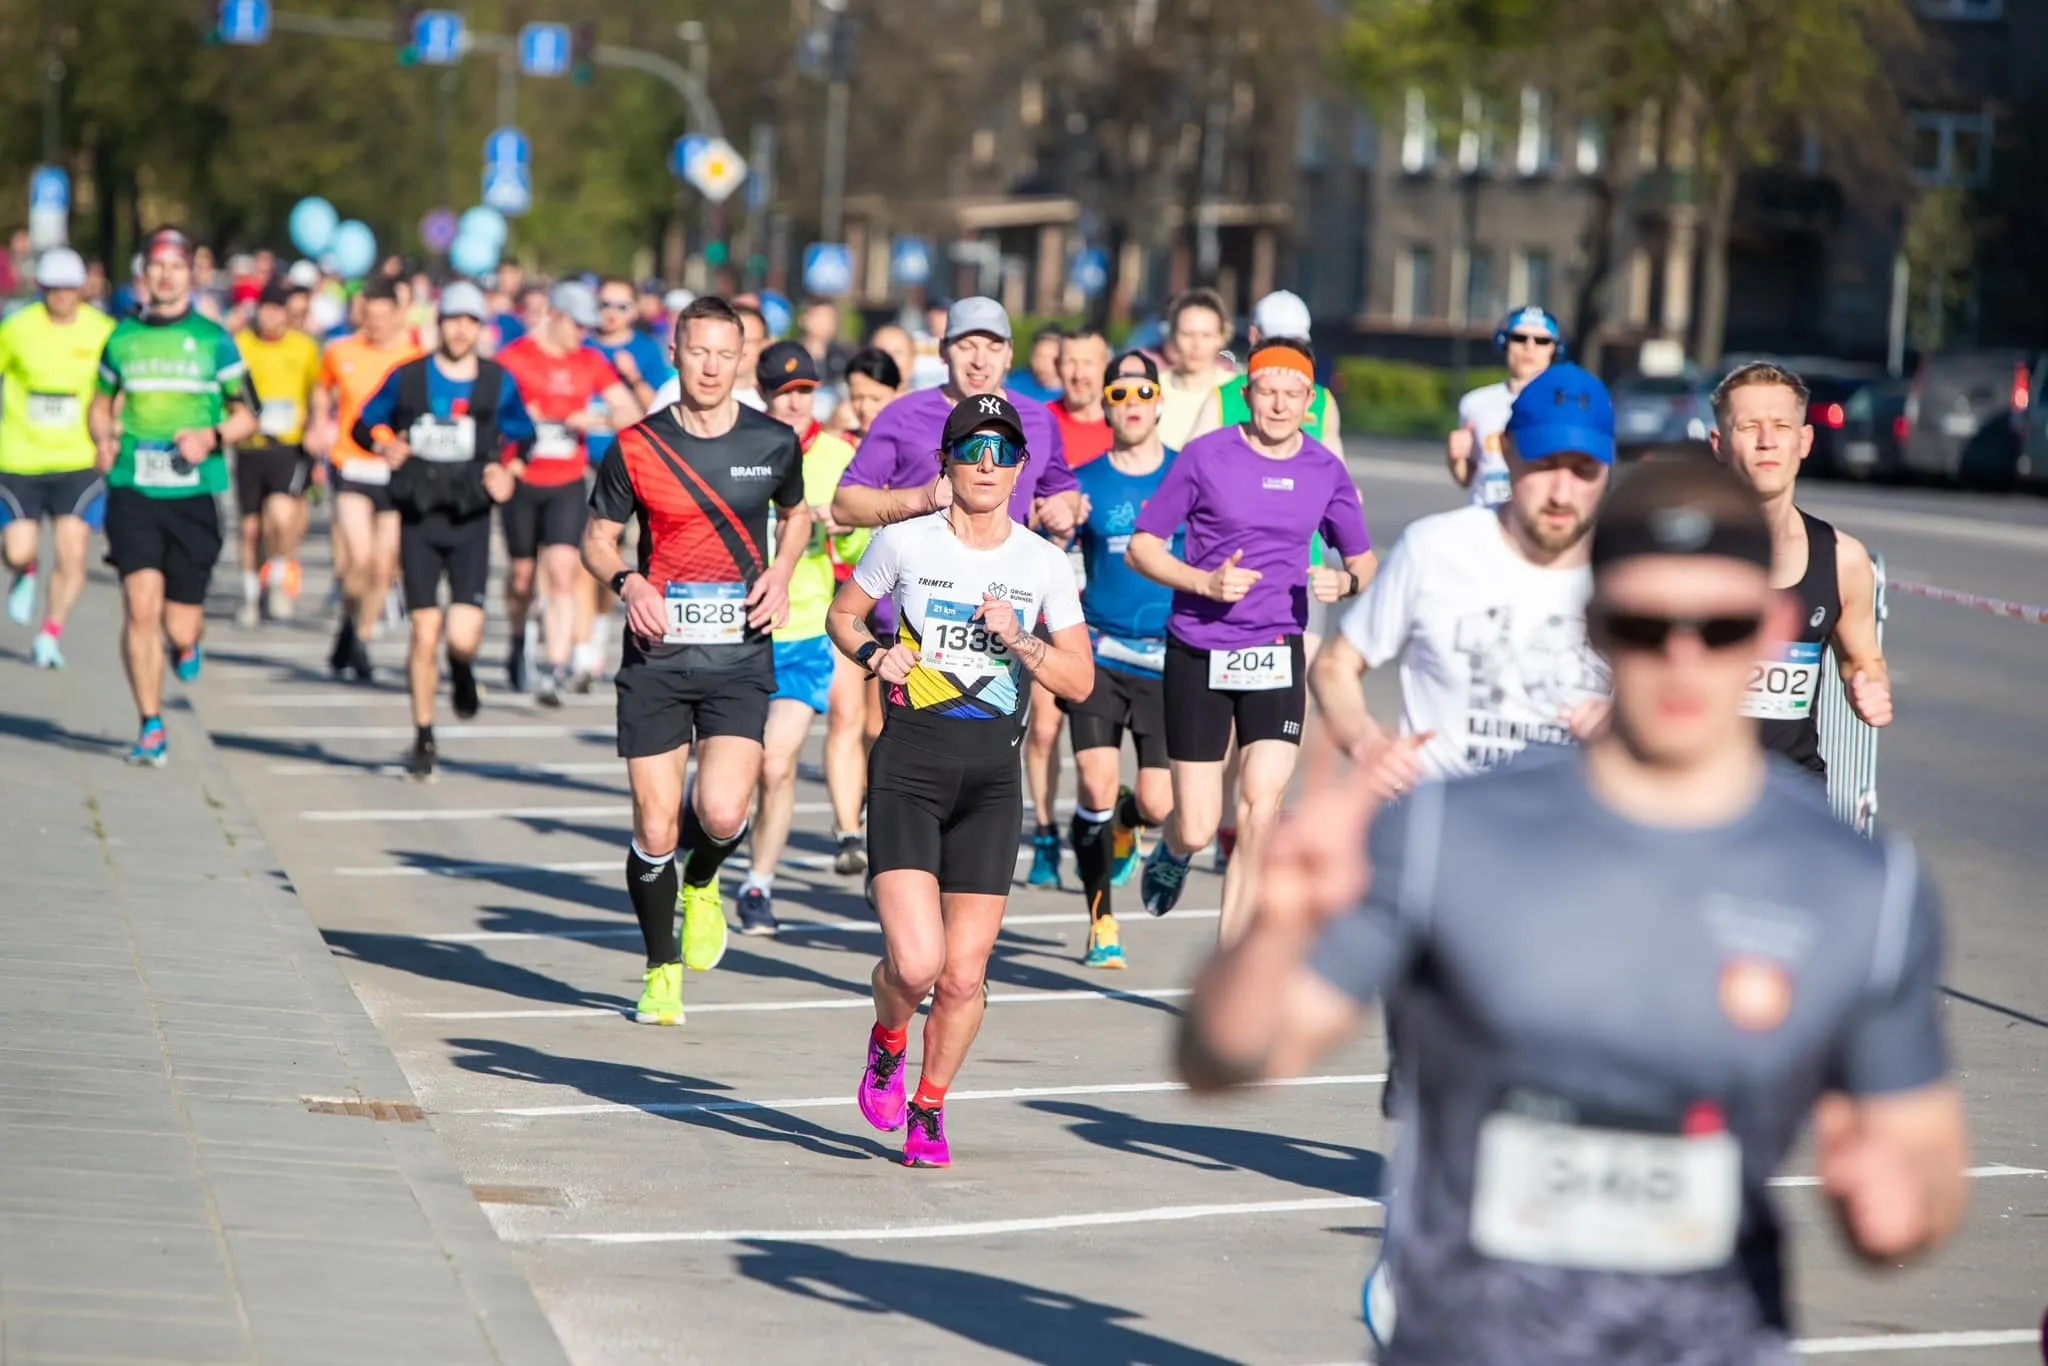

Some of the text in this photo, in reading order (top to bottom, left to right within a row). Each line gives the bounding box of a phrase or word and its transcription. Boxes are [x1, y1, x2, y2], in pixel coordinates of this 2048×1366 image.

[979, 396, 1001, 415] NY
[918, 577, 954, 589] TRIMTEX
[674, 603, 735, 624] 1628
[933, 604, 956, 615] 21 km
[1227, 650, 1274, 671] 204
